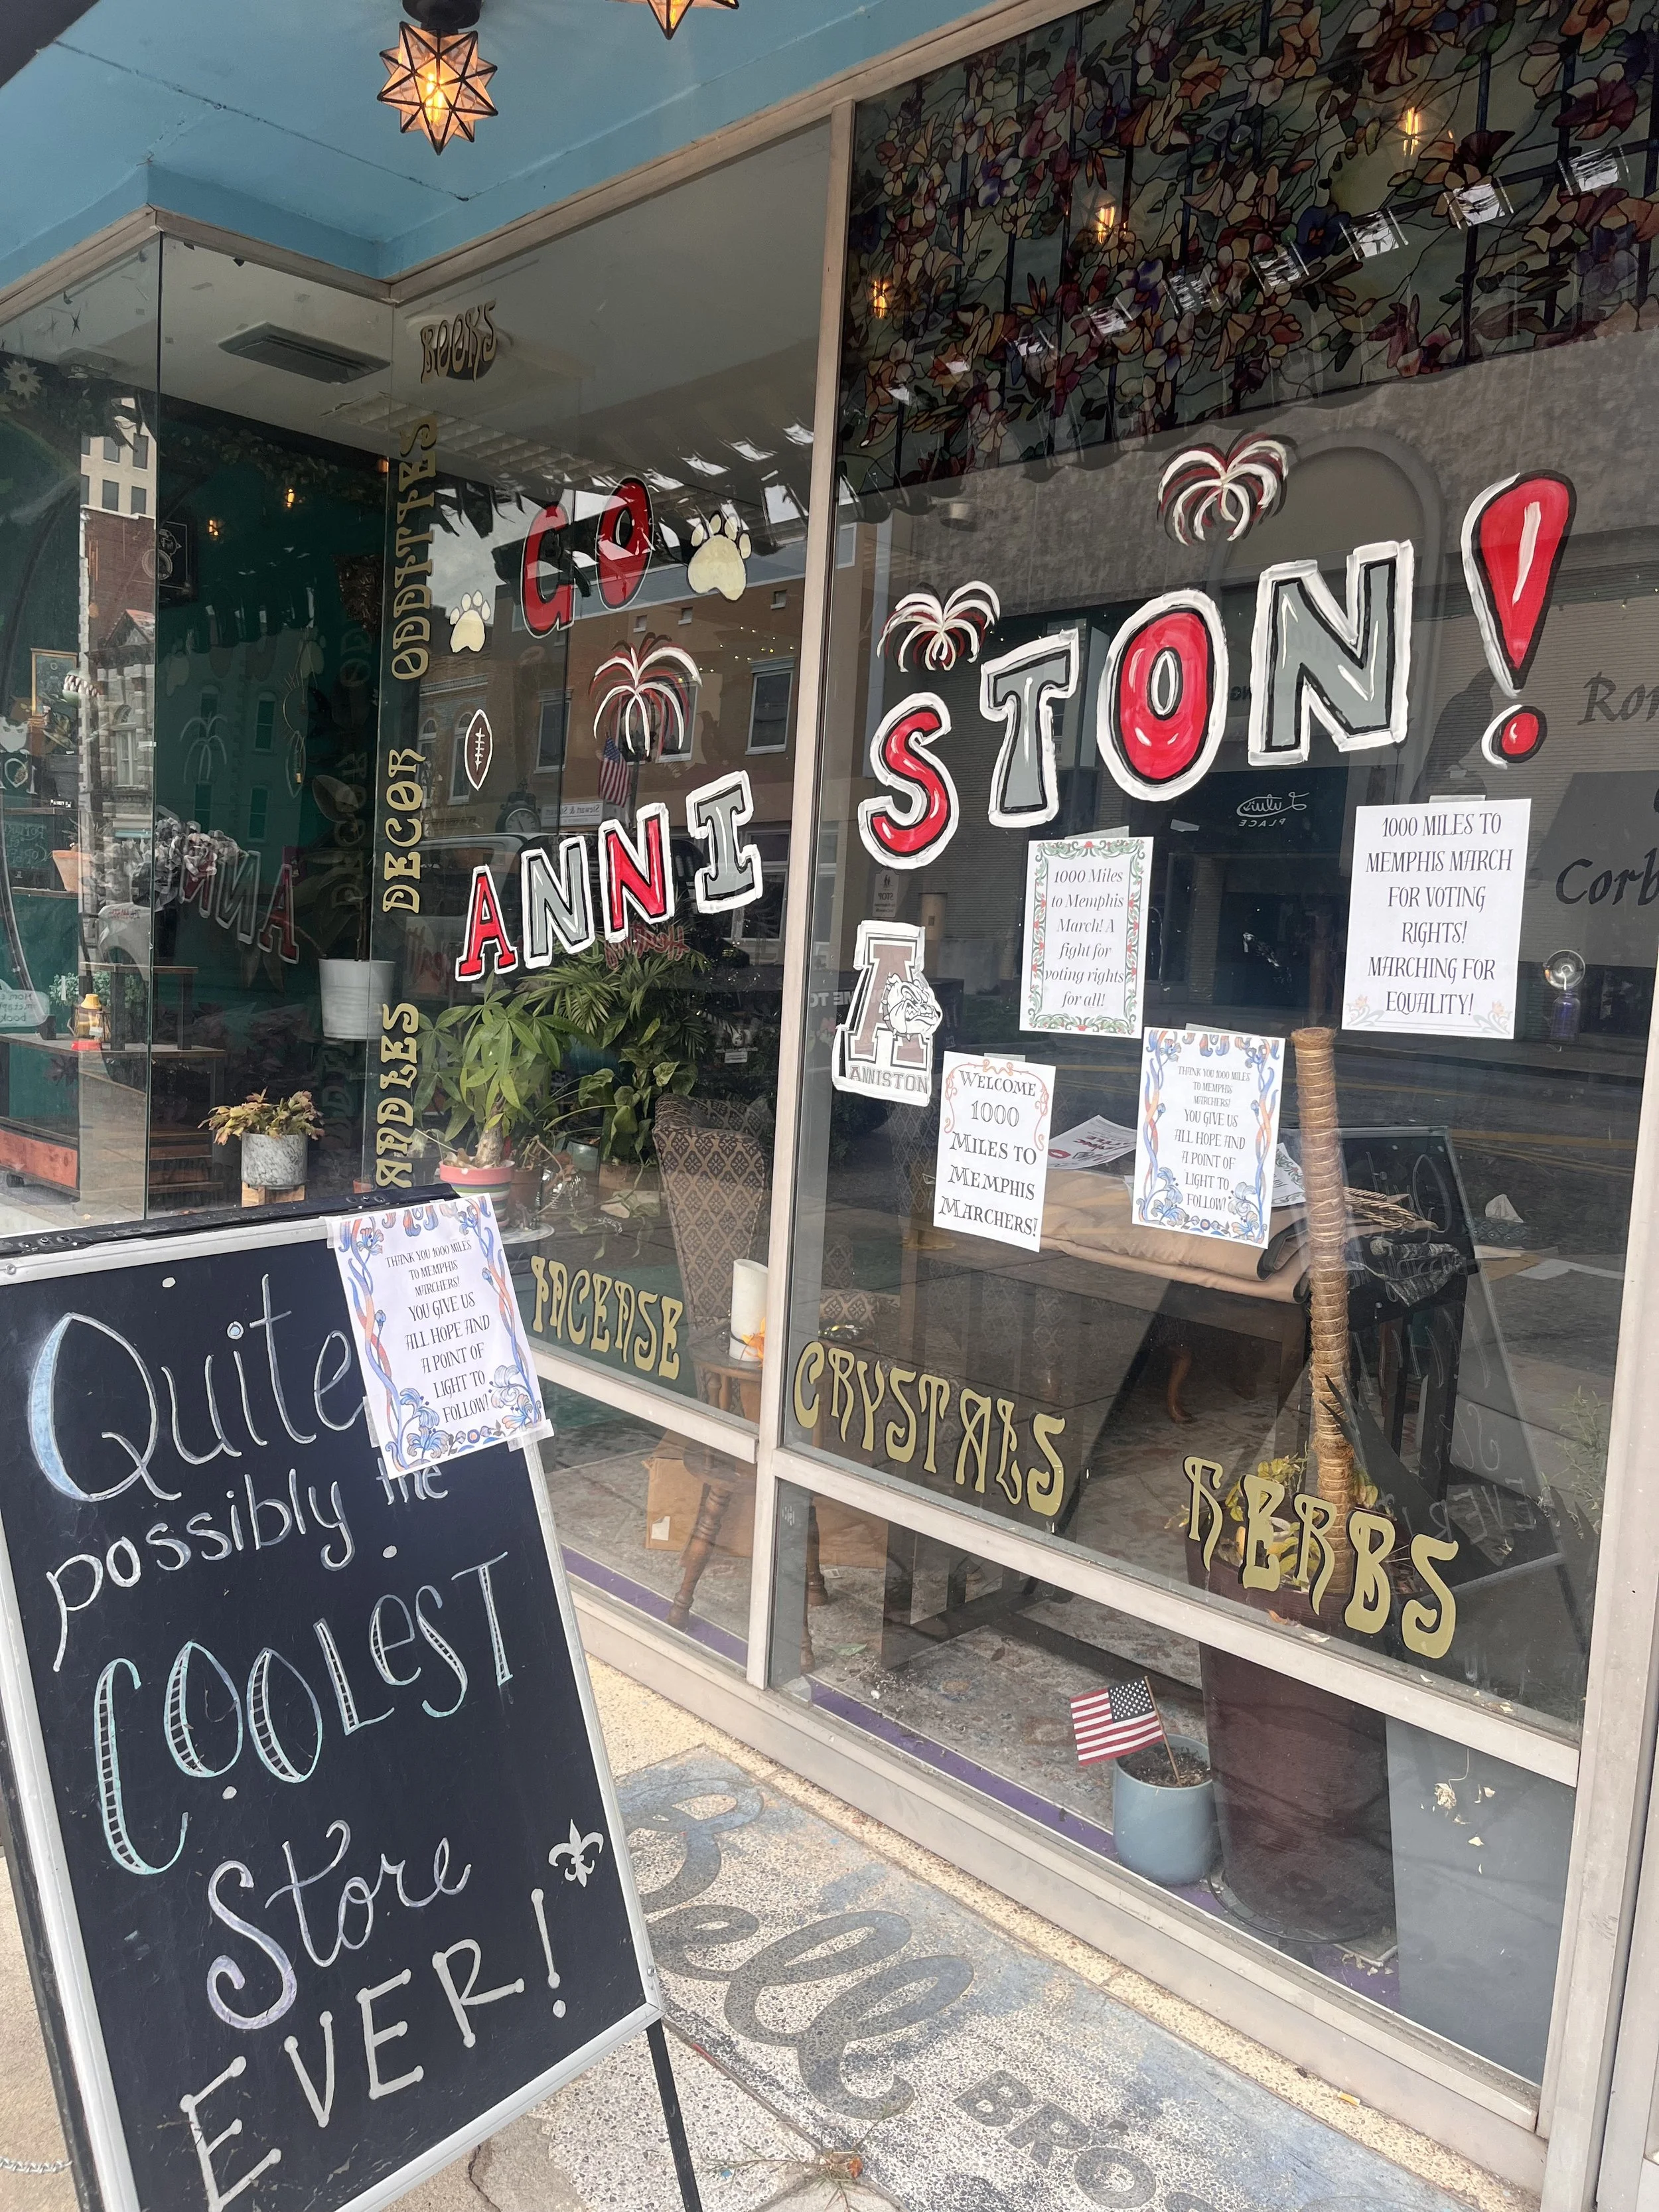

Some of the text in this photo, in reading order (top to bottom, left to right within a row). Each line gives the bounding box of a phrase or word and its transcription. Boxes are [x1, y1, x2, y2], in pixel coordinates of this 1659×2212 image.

[420, 297, 496, 385] BOOKS
[392, 415, 437, 681] ODDITIES
[521, 476, 654, 638] GO
[382, 748, 426, 914] DECOR
[1382, 812, 1501, 837] 1000 MILES TO
[1366, 849, 1513, 873] MEMPHIS MARCH
[455, 770, 763, 982] ANNI
[1054, 868, 1123, 883] 1000 Miles
[1051, 894, 1124, 911] to Memphis
[1388, 886, 1486, 913] FOR VOTING
[1056, 919, 1116, 932] March! A
[1402, 921, 1468, 948] RIGHTS!
[1058, 943, 1112, 961] fight for
[1045, 968, 1124, 986] voting rights
[1367, 956, 1495, 985] MARCHING FOR
[1061, 991, 1106, 1008] for all!
[1386, 991, 1474, 1016] EQUALITY!
[848, 1065, 928, 1094] ANNISTON
[959, 1070, 1037, 1097] WELCOME
[1178, 1066, 1251, 1082] THANK YOU 1000 MILES
[1192, 1082, 1232, 1094] TO MEMPHIS
[376, 1003, 419, 1189] ANDLES
[1194, 1096, 1231, 1108] MARCHERS!
[971, 1101, 1019, 1127] 1000
[1184, 1109, 1239, 1128] YOU GIVE US
[950, 1132, 1037, 1165] MILES TO
[1174, 1129, 1246, 1150] ALL HOPE AND
[1181, 1151, 1236, 1170] A POINT OF
[948, 1165, 1035, 1200] MEMPHIS
[1185, 1172, 1230, 1191] LIGHT TO
[1187, 1193, 1226, 1212] FOLLOW!
[938, 1197, 1038, 1237] MARCHERS!
[385, 1240, 472, 1268] THANK YOU 1000 MILES
[409, 1260, 459, 1280] TO MEMPHIS
[415, 1276, 460, 1297] MARCHERS!
[408, 1292, 475, 1322] YOU GIVE US
[531, 1254, 686, 1381] INCENSE
[405, 1315, 490, 1351] ALL HOPE AND
[421, 1343, 485, 1374] A POINT OF
[29, 1274, 364, 1501] Quite
[433, 1370, 486, 1400] LIGHT TO
[442, 1395, 489, 1423] FOLLOW!
[793, 1339, 1066, 1516] CRYSTALS
[46, 1468, 355, 1672] possibly
[1183, 1455, 1459, 1660] HERBS
[206, 1819, 472, 2030] Store
[180, 1888, 567, 2212] EVER!
